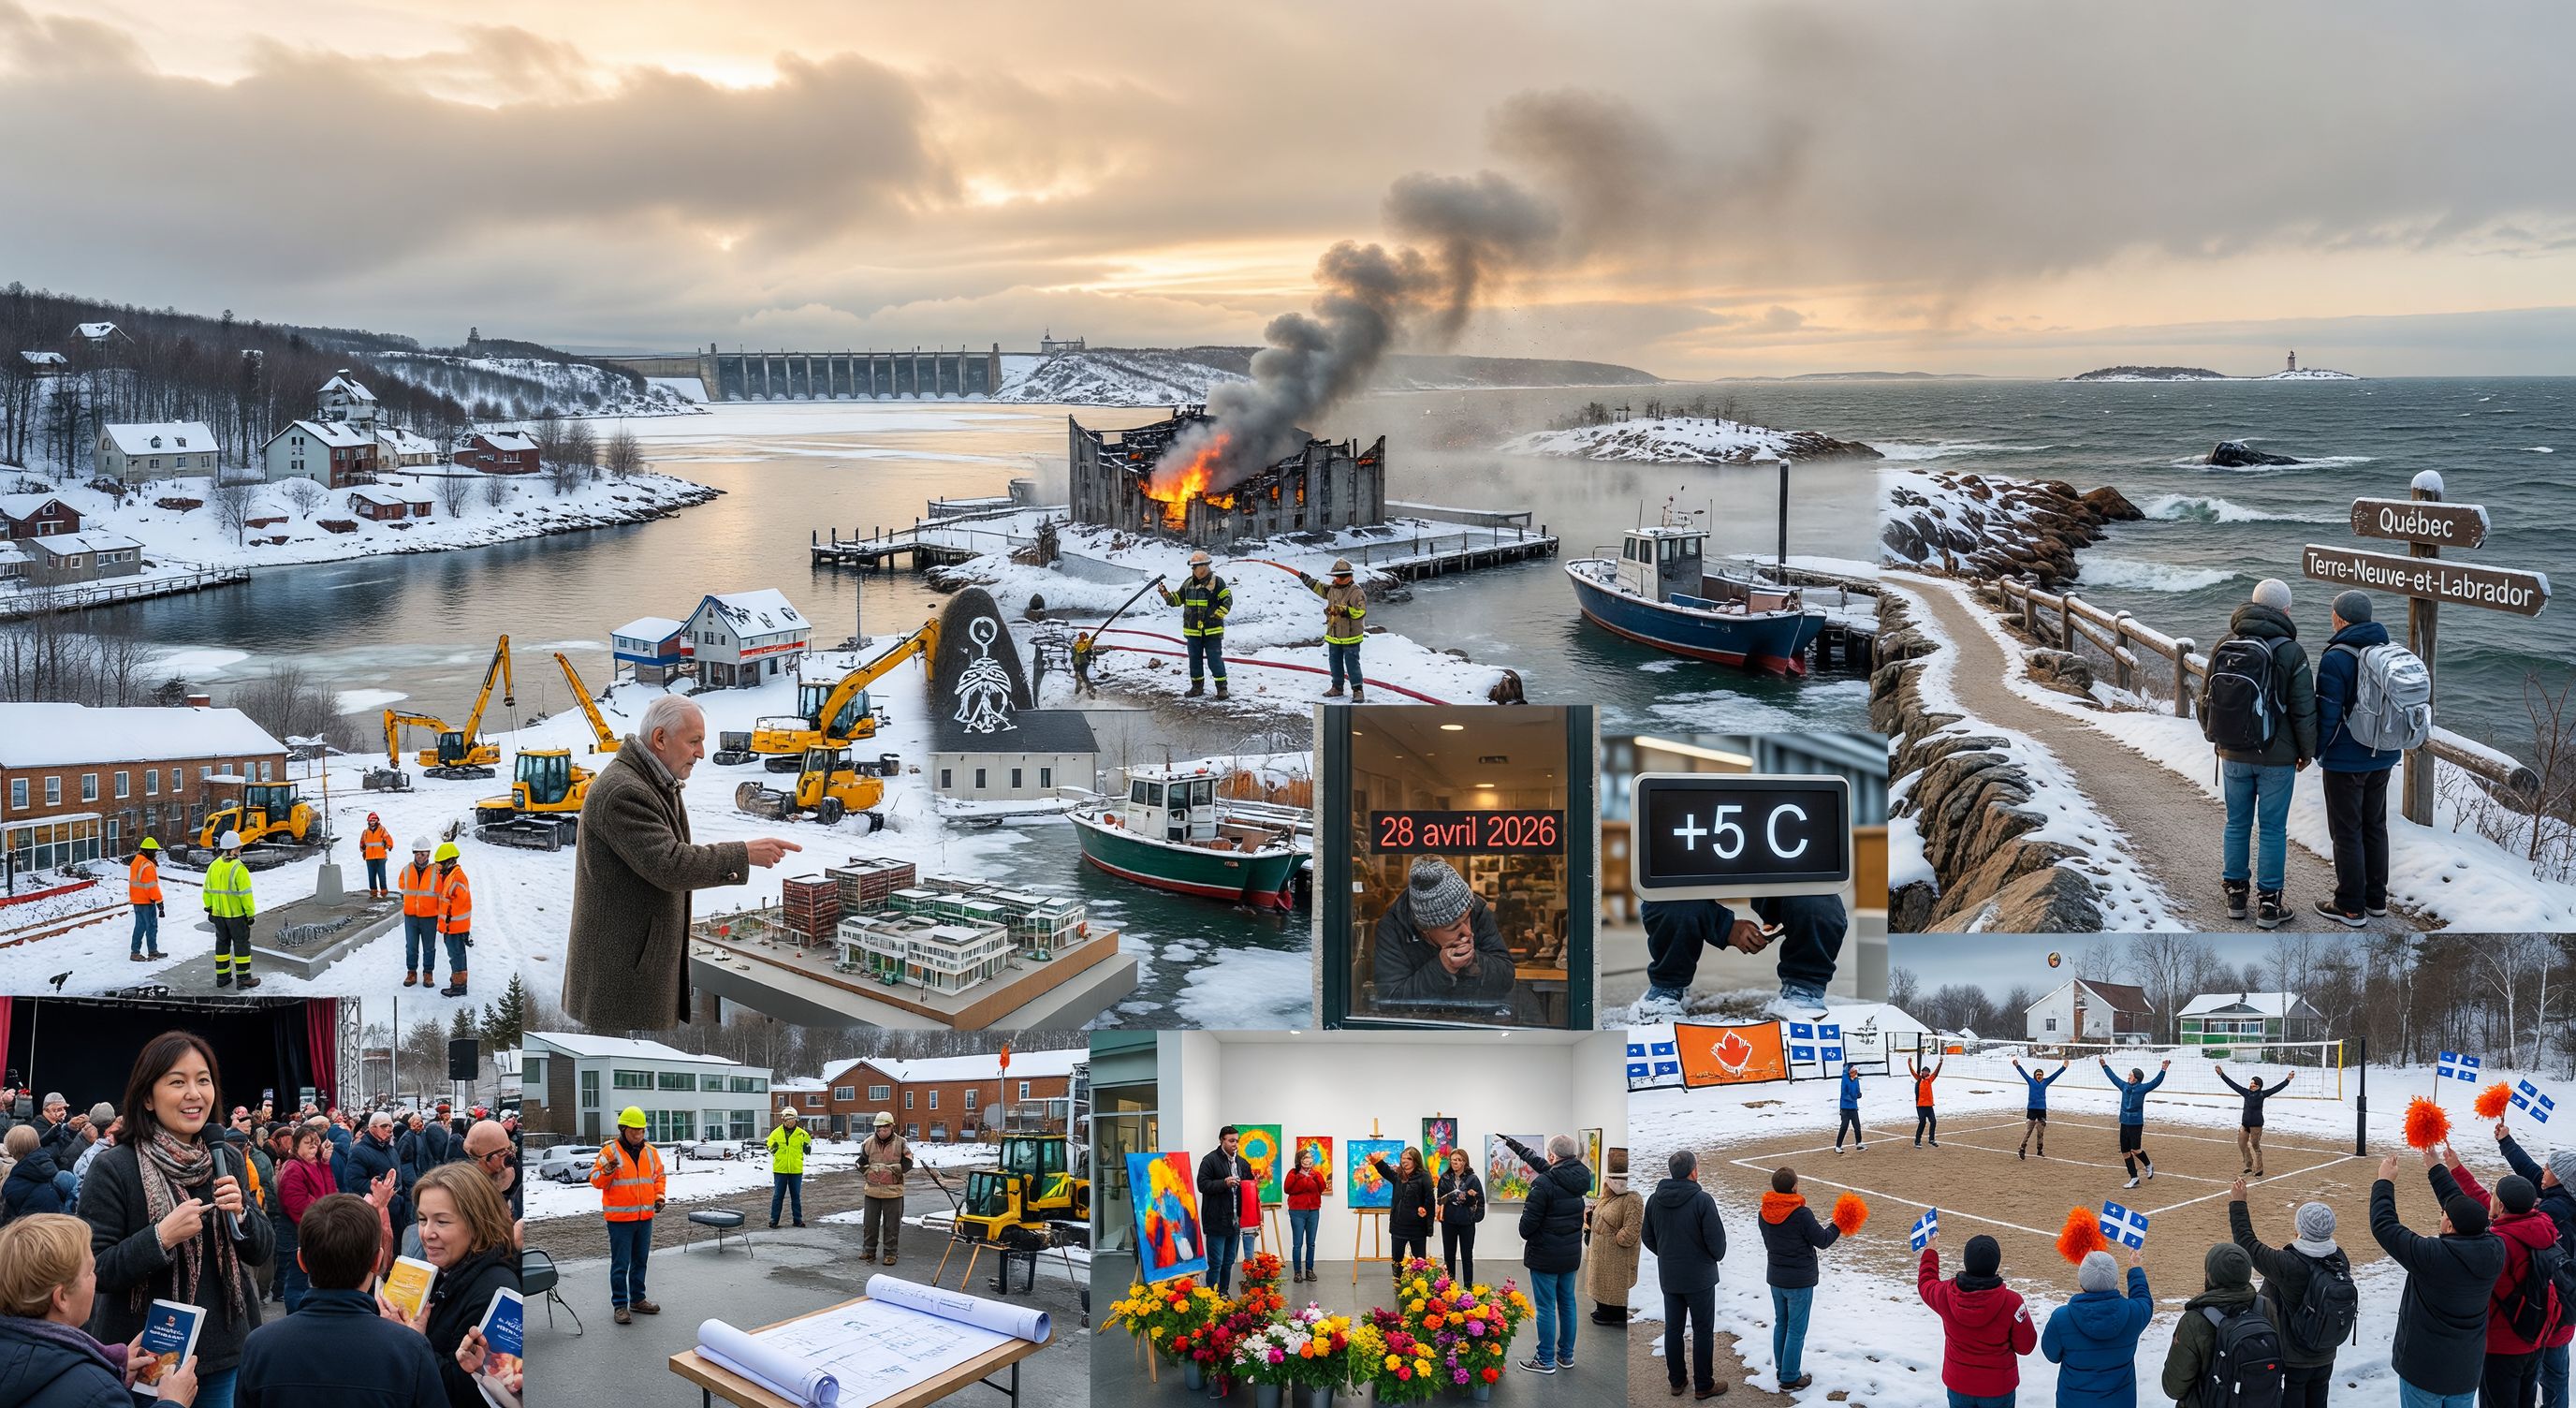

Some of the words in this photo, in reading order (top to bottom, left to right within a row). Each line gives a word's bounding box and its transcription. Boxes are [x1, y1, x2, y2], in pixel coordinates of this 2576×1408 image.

[2379, 506, 2454, 538] Québec
[2307, 551, 2534, 607] Terre-Neuve-et-Labrador
[1380, 815, 1414, 847] 28
[1423, 815, 1476, 846] avril
[1486, 815, 1557, 846] 2026
[1673, 804, 1745, 859] +5
[1766, 803, 1808, 858] C
